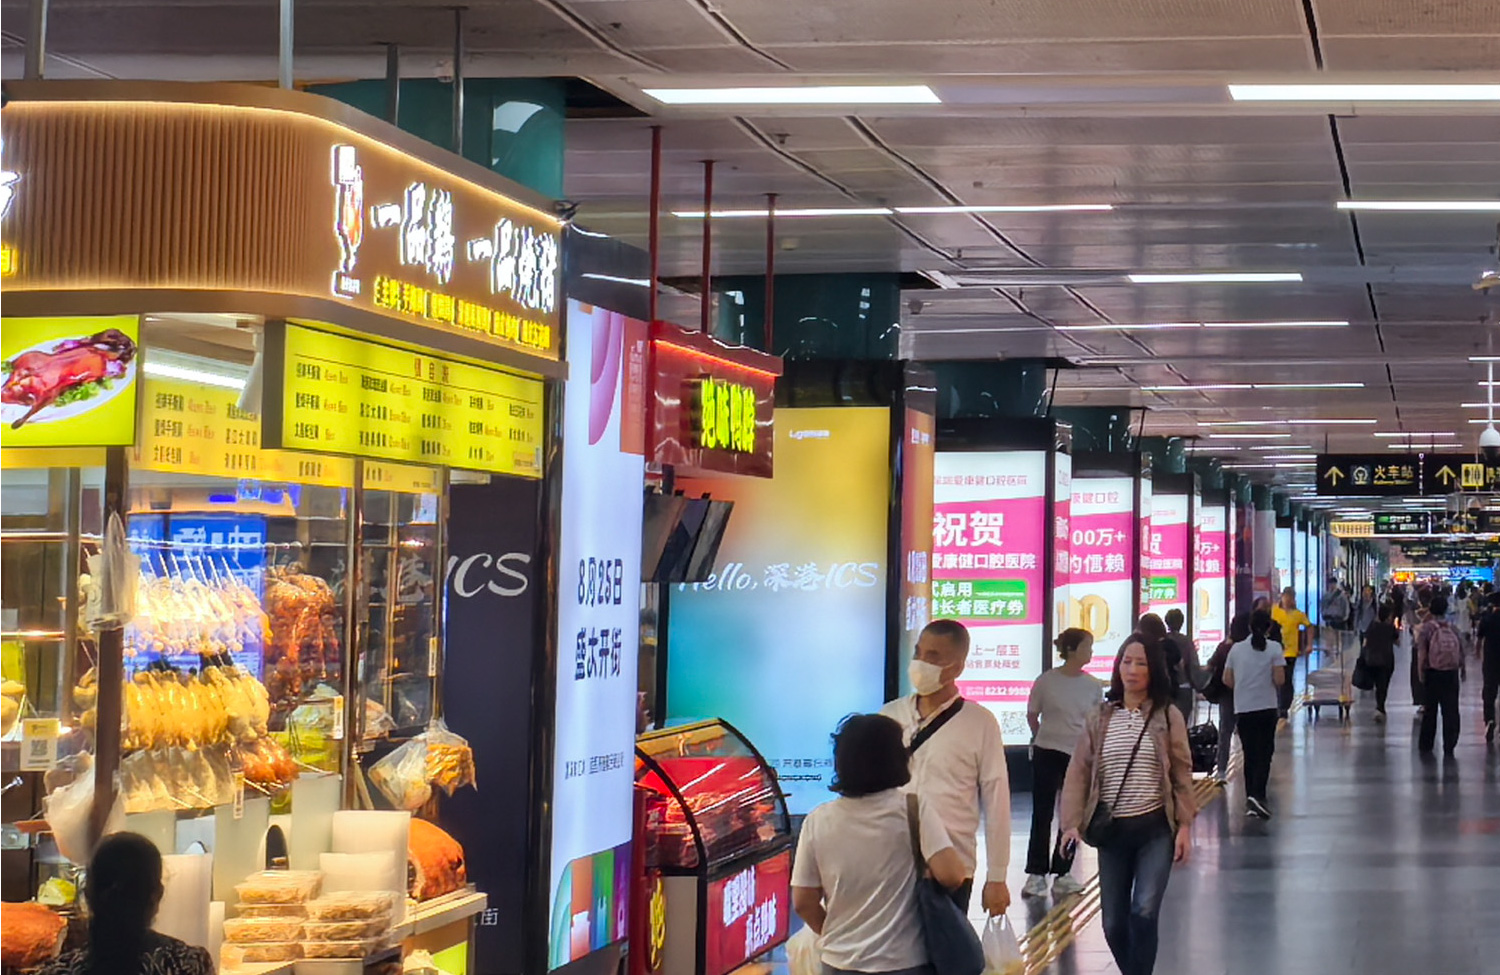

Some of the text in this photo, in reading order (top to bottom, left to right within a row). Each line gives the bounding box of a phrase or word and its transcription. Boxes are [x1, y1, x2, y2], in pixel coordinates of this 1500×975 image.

[1373, 465, 1414, 479] 火车站
[932, 511, 1004, 547] 祝贺
[578, 557, 623, 608] 8月25日
[574, 627, 623, 681] 盛大开街
